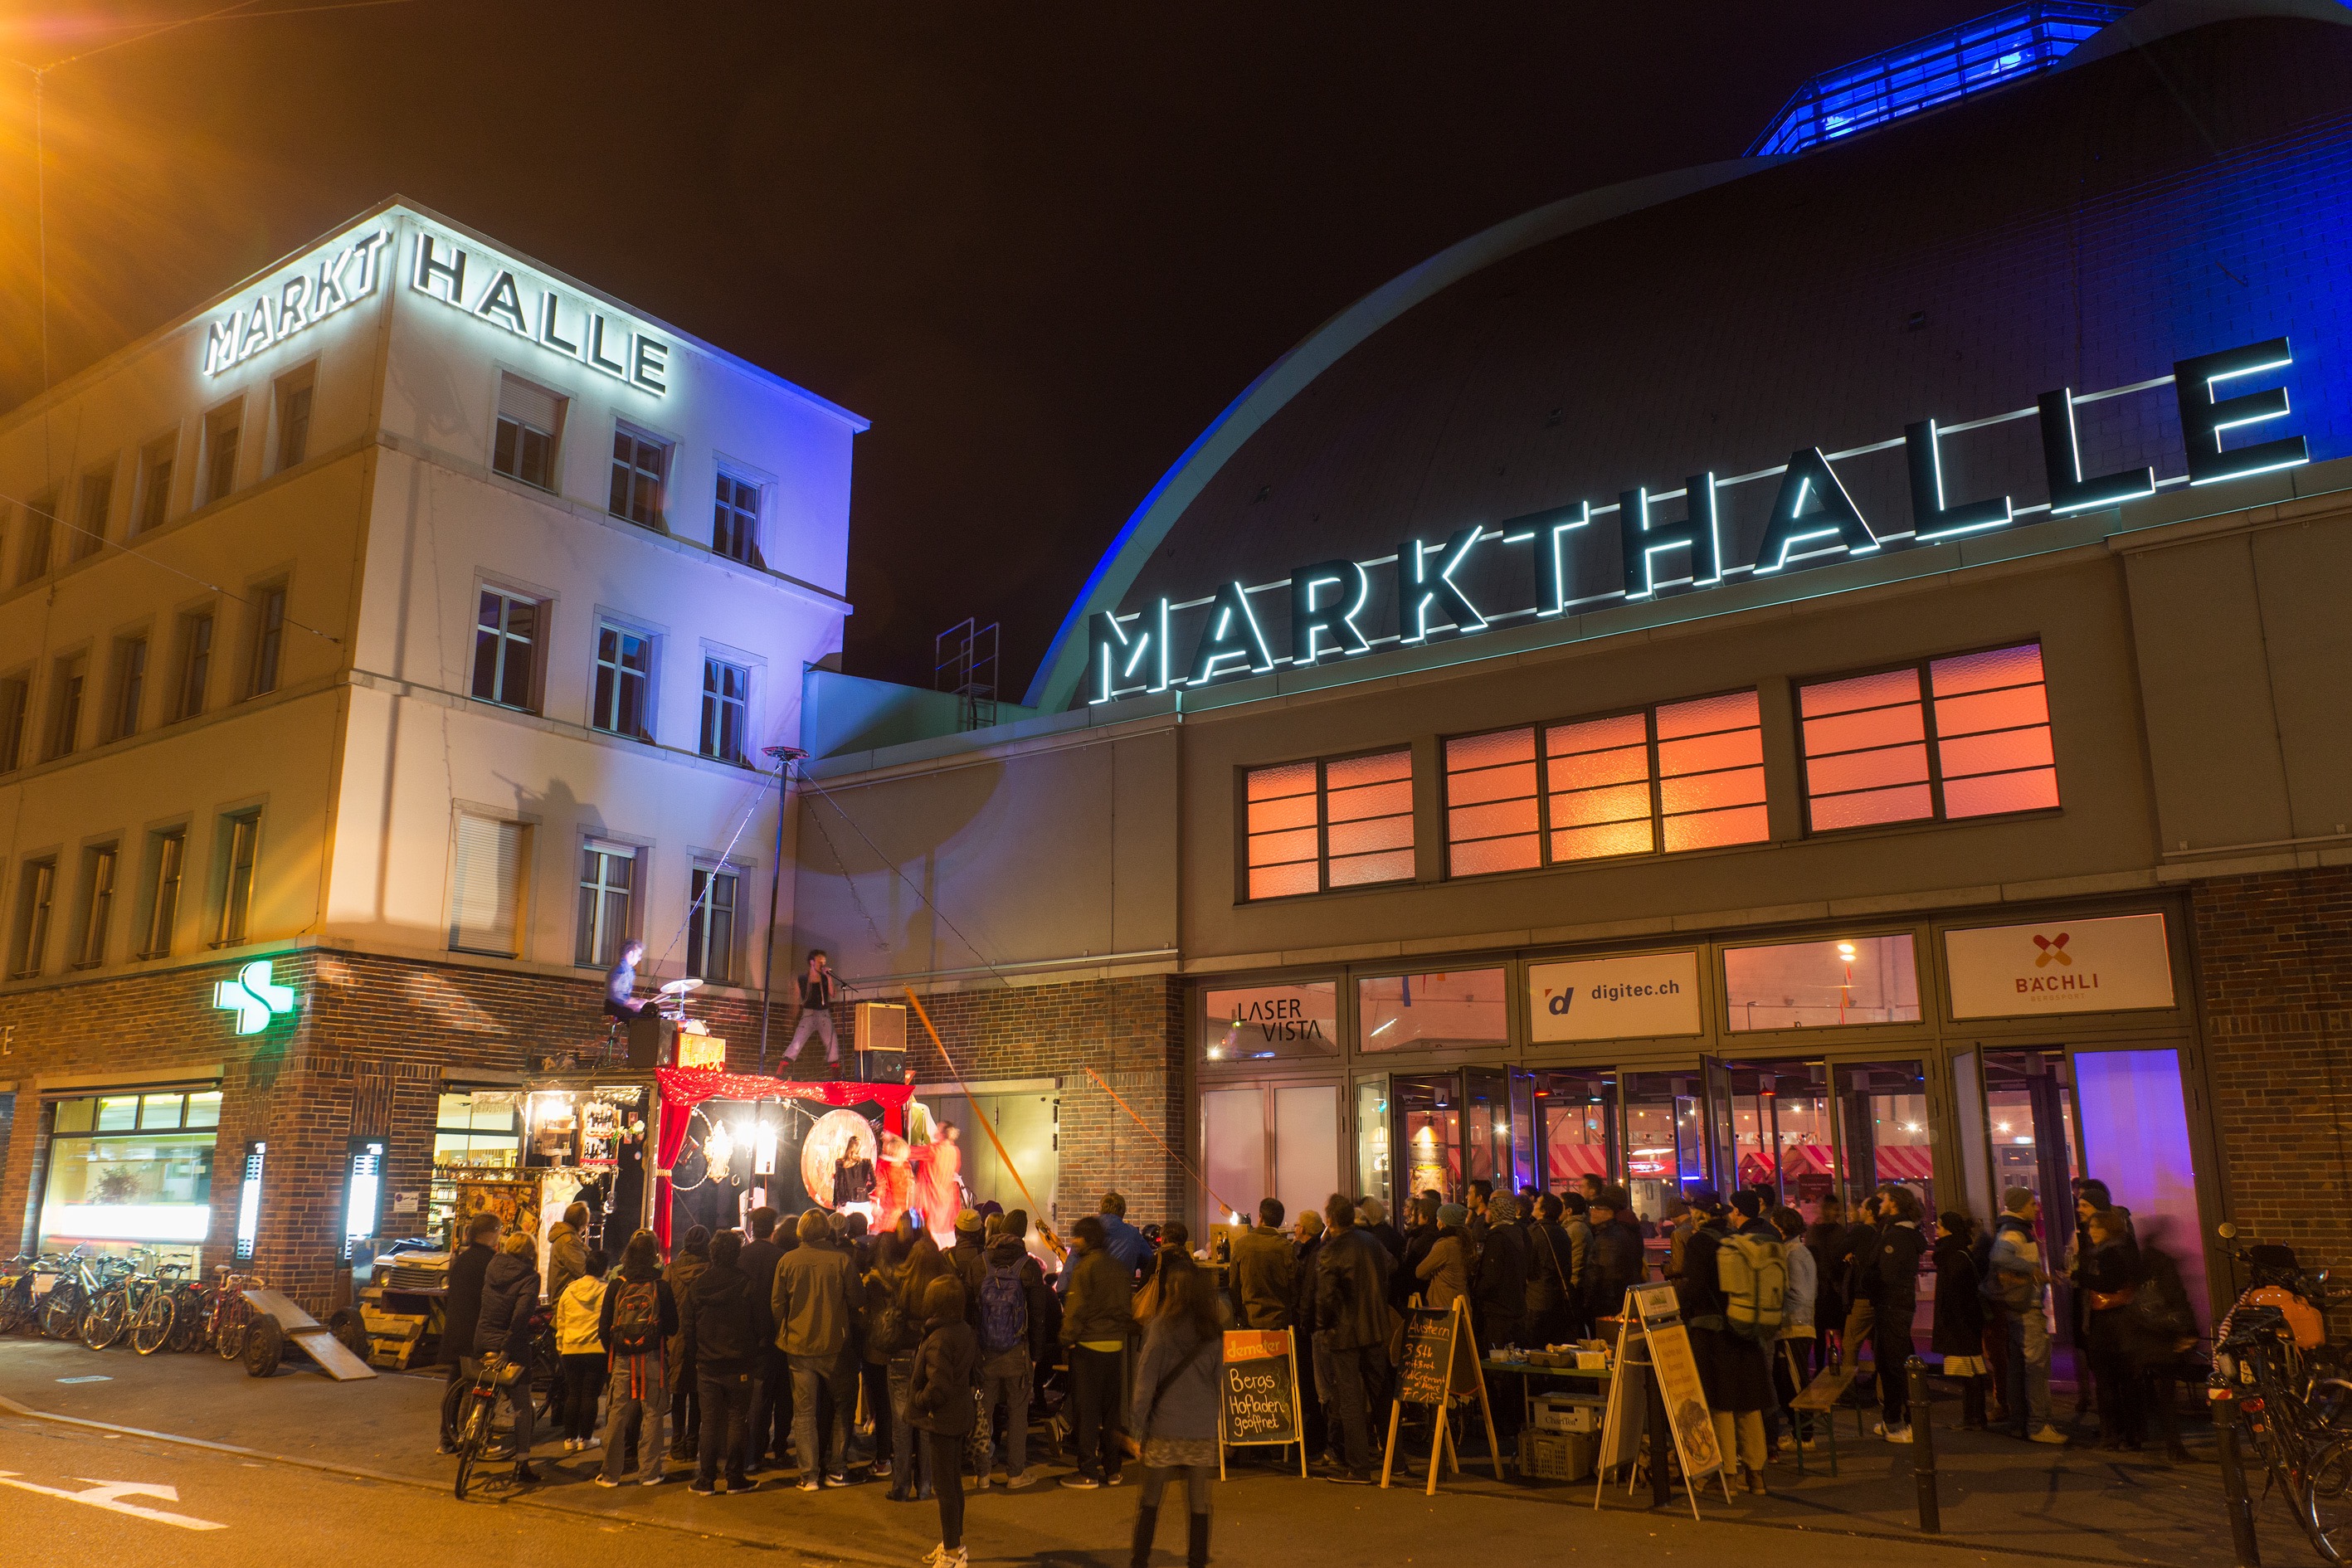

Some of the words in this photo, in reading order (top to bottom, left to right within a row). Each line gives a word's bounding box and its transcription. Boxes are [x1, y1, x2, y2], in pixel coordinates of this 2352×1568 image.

[202, 227, 392, 377] MARKT
[410, 231, 669, 397] HALLE
[1088, 336, 2310, 705] MARKTHALLE
[1591, 980, 1679, 1001] digitec.ch
[2015, 973, 2098, 993] BÄCHLI
[2030, 993, 2085, 1002] BERGSPORT
[1238, 999, 1302, 1021] LASER
[1262, 1020, 1322, 1042] VISTA
[1408, 1312, 1449, 1337] Austern
[1227, 1340, 1280, 1359] demeter
[1403, 1343, 1413, 1359] 3
[1230, 1368, 1275, 1394] Bergs
[1229, 1394, 1285, 1418] Hofladen
